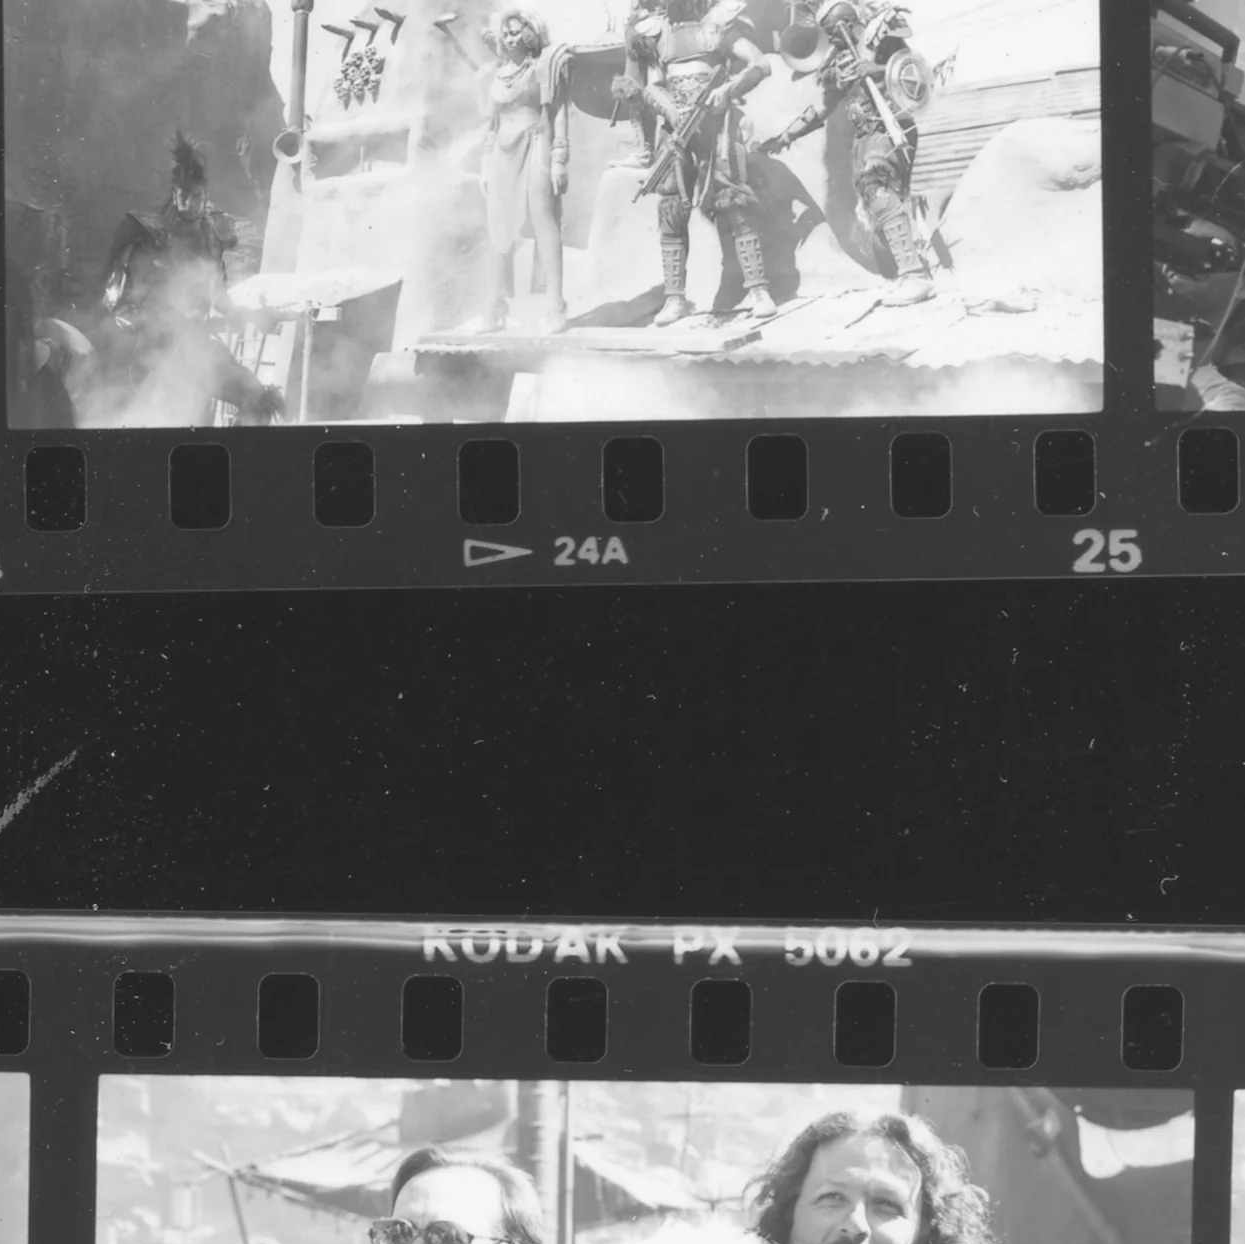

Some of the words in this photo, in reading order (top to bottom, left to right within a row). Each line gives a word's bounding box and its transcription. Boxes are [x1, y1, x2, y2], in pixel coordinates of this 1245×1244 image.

[553, 535, 629, 567] 24A
[1071, 527, 1143, 574] 25
[421, 924, 630, 965] KODAK
[672, 926, 743, 966] PX
[783, 926, 913, 968] 5062
